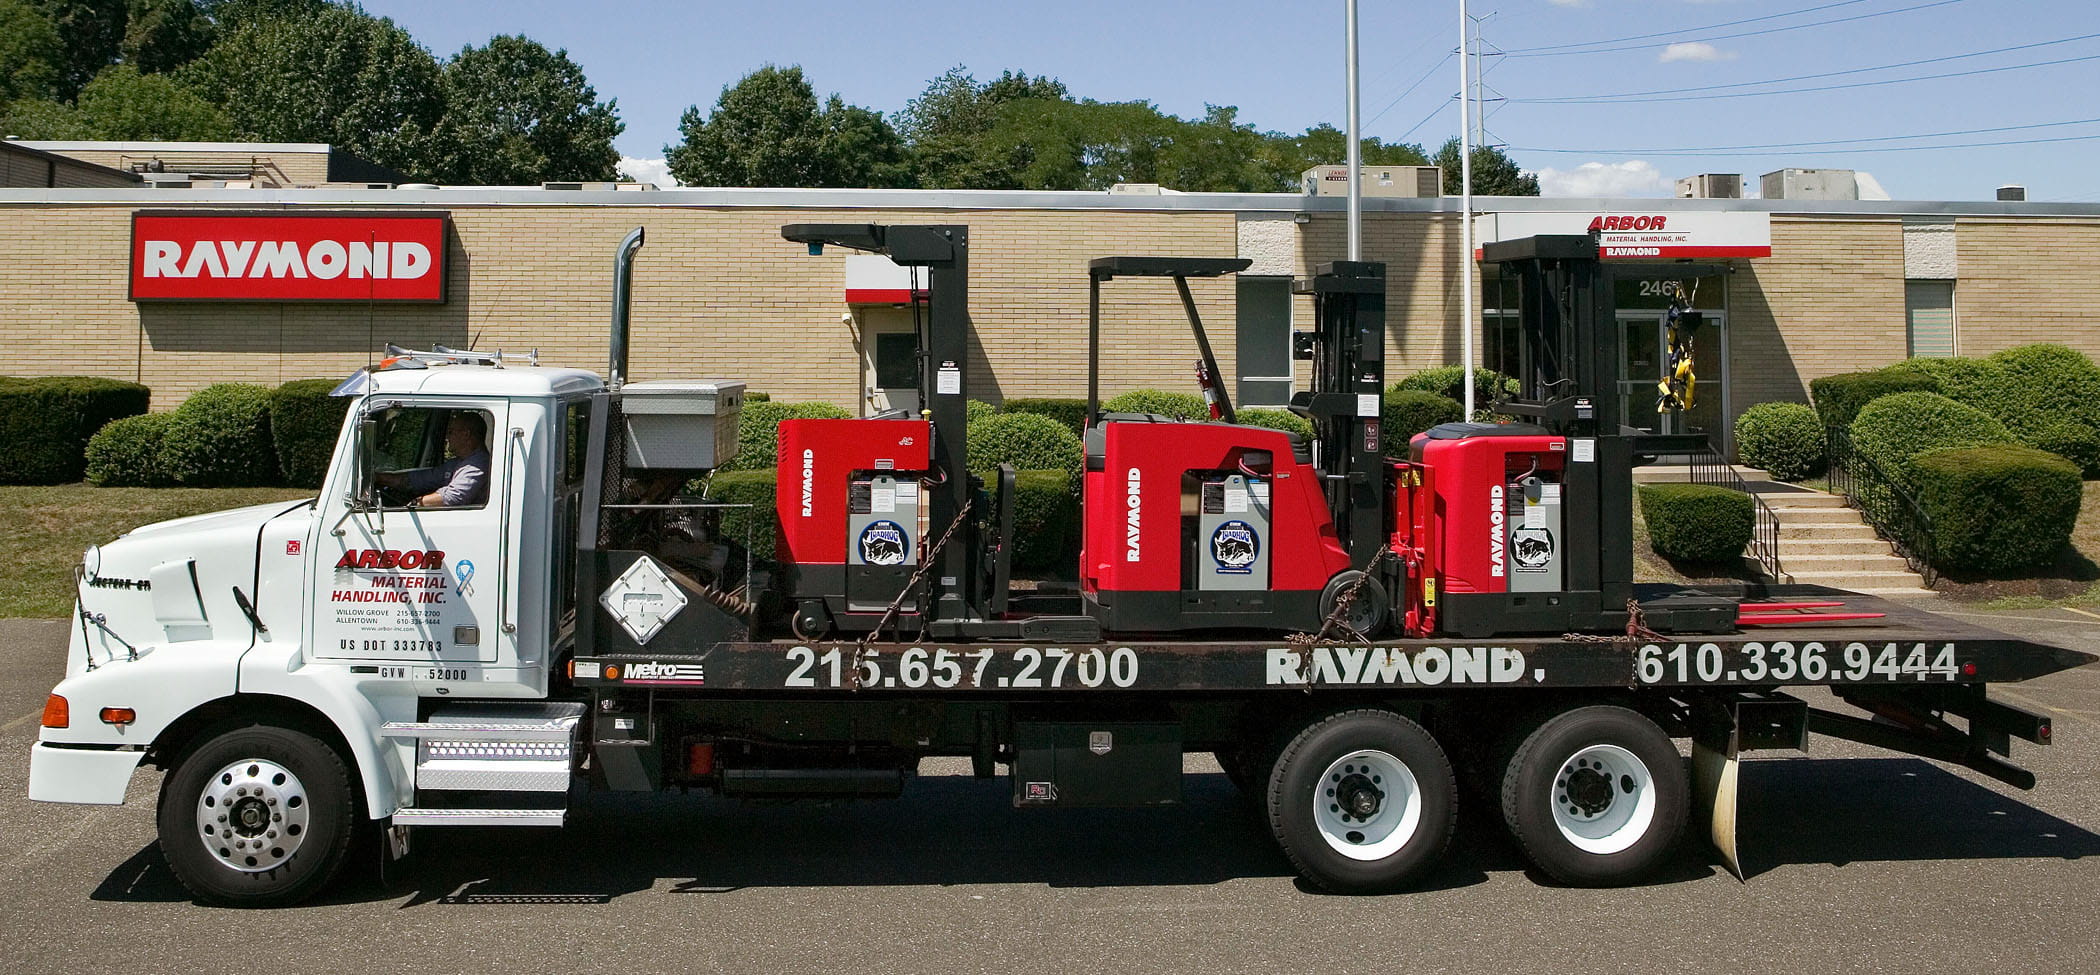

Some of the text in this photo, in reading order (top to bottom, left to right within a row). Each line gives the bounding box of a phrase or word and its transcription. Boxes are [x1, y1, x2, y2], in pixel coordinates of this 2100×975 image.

[1587, 215, 1666, 231] ARBOR
[143, 240, 432, 280] RAYMOND
[1606, 247, 1661, 256] RAYMOND
[802, 448, 813, 517] RAYMOND
[1127, 467, 1141, 562] RAYMOND
[1490, 485, 1504, 577] RAYMOND
[334, 549, 446, 571] ARBOR
[371, 576, 447, 589] MATERIAL
[331, 591, 447, 605] HANDLING, INC.
[340, 639, 442, 652] US DOT 333783
[623, 661, 677, 679] Metro
[784, 646, 1139, 689] 215.657.2700
[1637, 642, 1959, 683] 610.336.9444
[381, 667, 467, 680] GVW 52000
